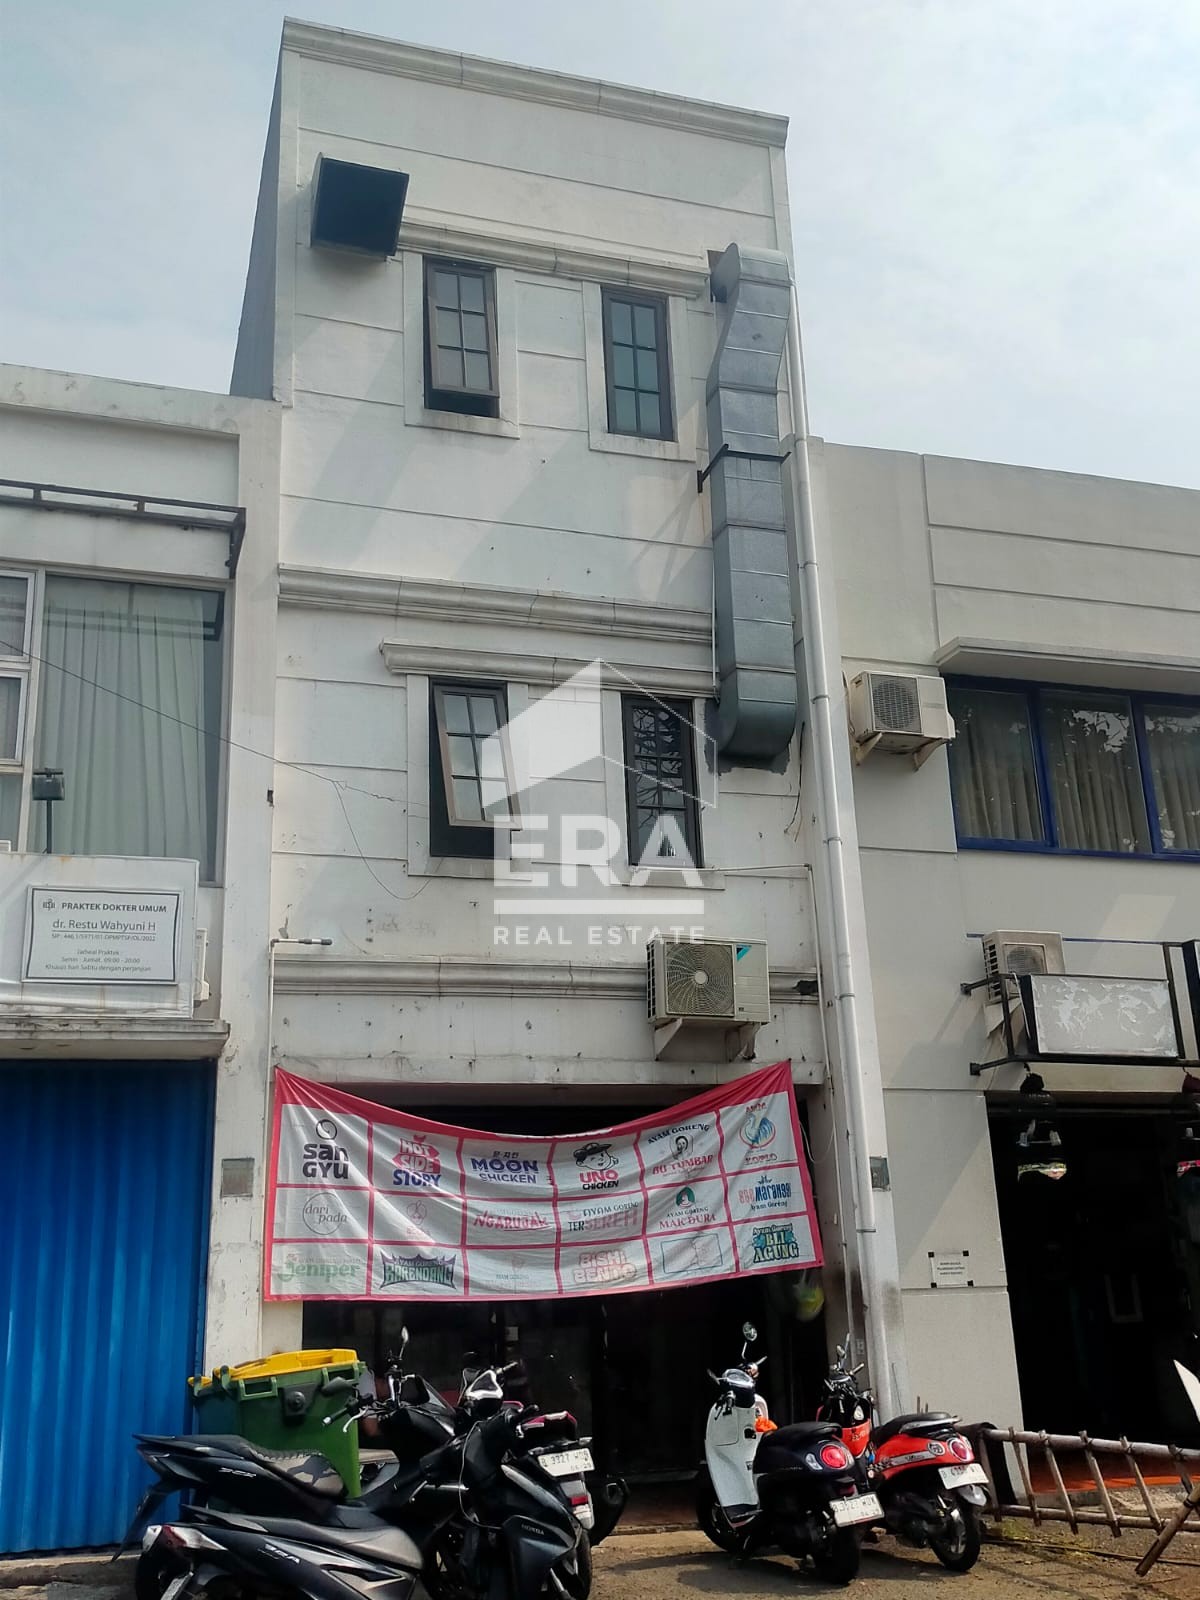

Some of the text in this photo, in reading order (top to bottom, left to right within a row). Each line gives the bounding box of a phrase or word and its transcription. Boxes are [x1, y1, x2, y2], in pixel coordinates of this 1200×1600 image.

[62, 902, 167, 913] PRAKTEK DOKTER UMUM
[52, 919, 156, 933] dr. Restu Wahyuni H
[648, 1123, 710, 1145] AYAM GORENG
[303, 1143, 349, 1161] san
[401, 1140, 430, 1156] HOT
[302, 1161, 349, 1179] GYU
[399, 1154, 434, 1173] SIDE
[471, 1158, 539, 1173] MOON
[393, 1169, 441, 1186] STORY
[579, 1169, 619, 1183] UNO
[582, 1180, 619, 1191] CHICKEN
[305, 1204, 329, 1215] dari
[583, 1206, 611, 1217] AYAM
[319, 1212, 348, 1225] pada
[765, 1231, 785, 1246] BLI
[754, 1242, 799, 1263] AGUNG
[386, 1263, 454, 1285] BARENDANG
